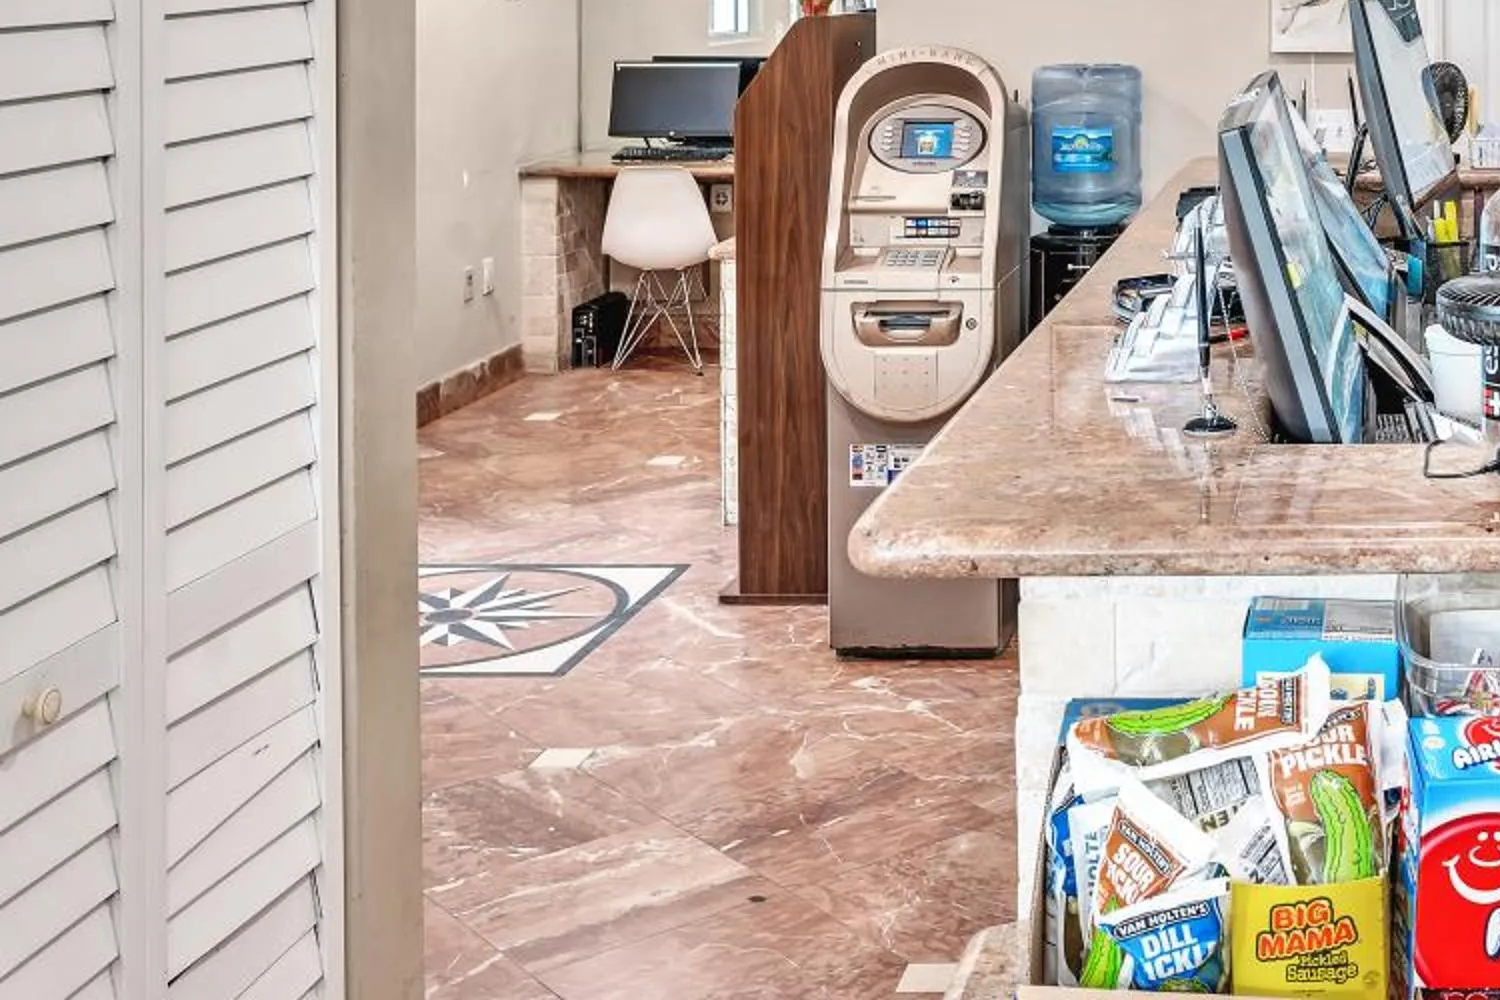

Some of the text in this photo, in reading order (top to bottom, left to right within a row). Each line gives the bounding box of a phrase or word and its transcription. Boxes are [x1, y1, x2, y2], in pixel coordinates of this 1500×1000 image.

[1281, 743, 1367, 779] PICKLE
[1112, 843, 1155, 892] SOUR
[1119, 902, 1208, 938] VAN HOLTEN'S
[1271, 899, 1331, 931] BIG
[1140, 923, 1199, 960] DILL
[1258, 917, 1356, 961] MAMA
[1287, 964, 1358, 983] Sausage
[1300, 950, 1348, 967] Pickled
